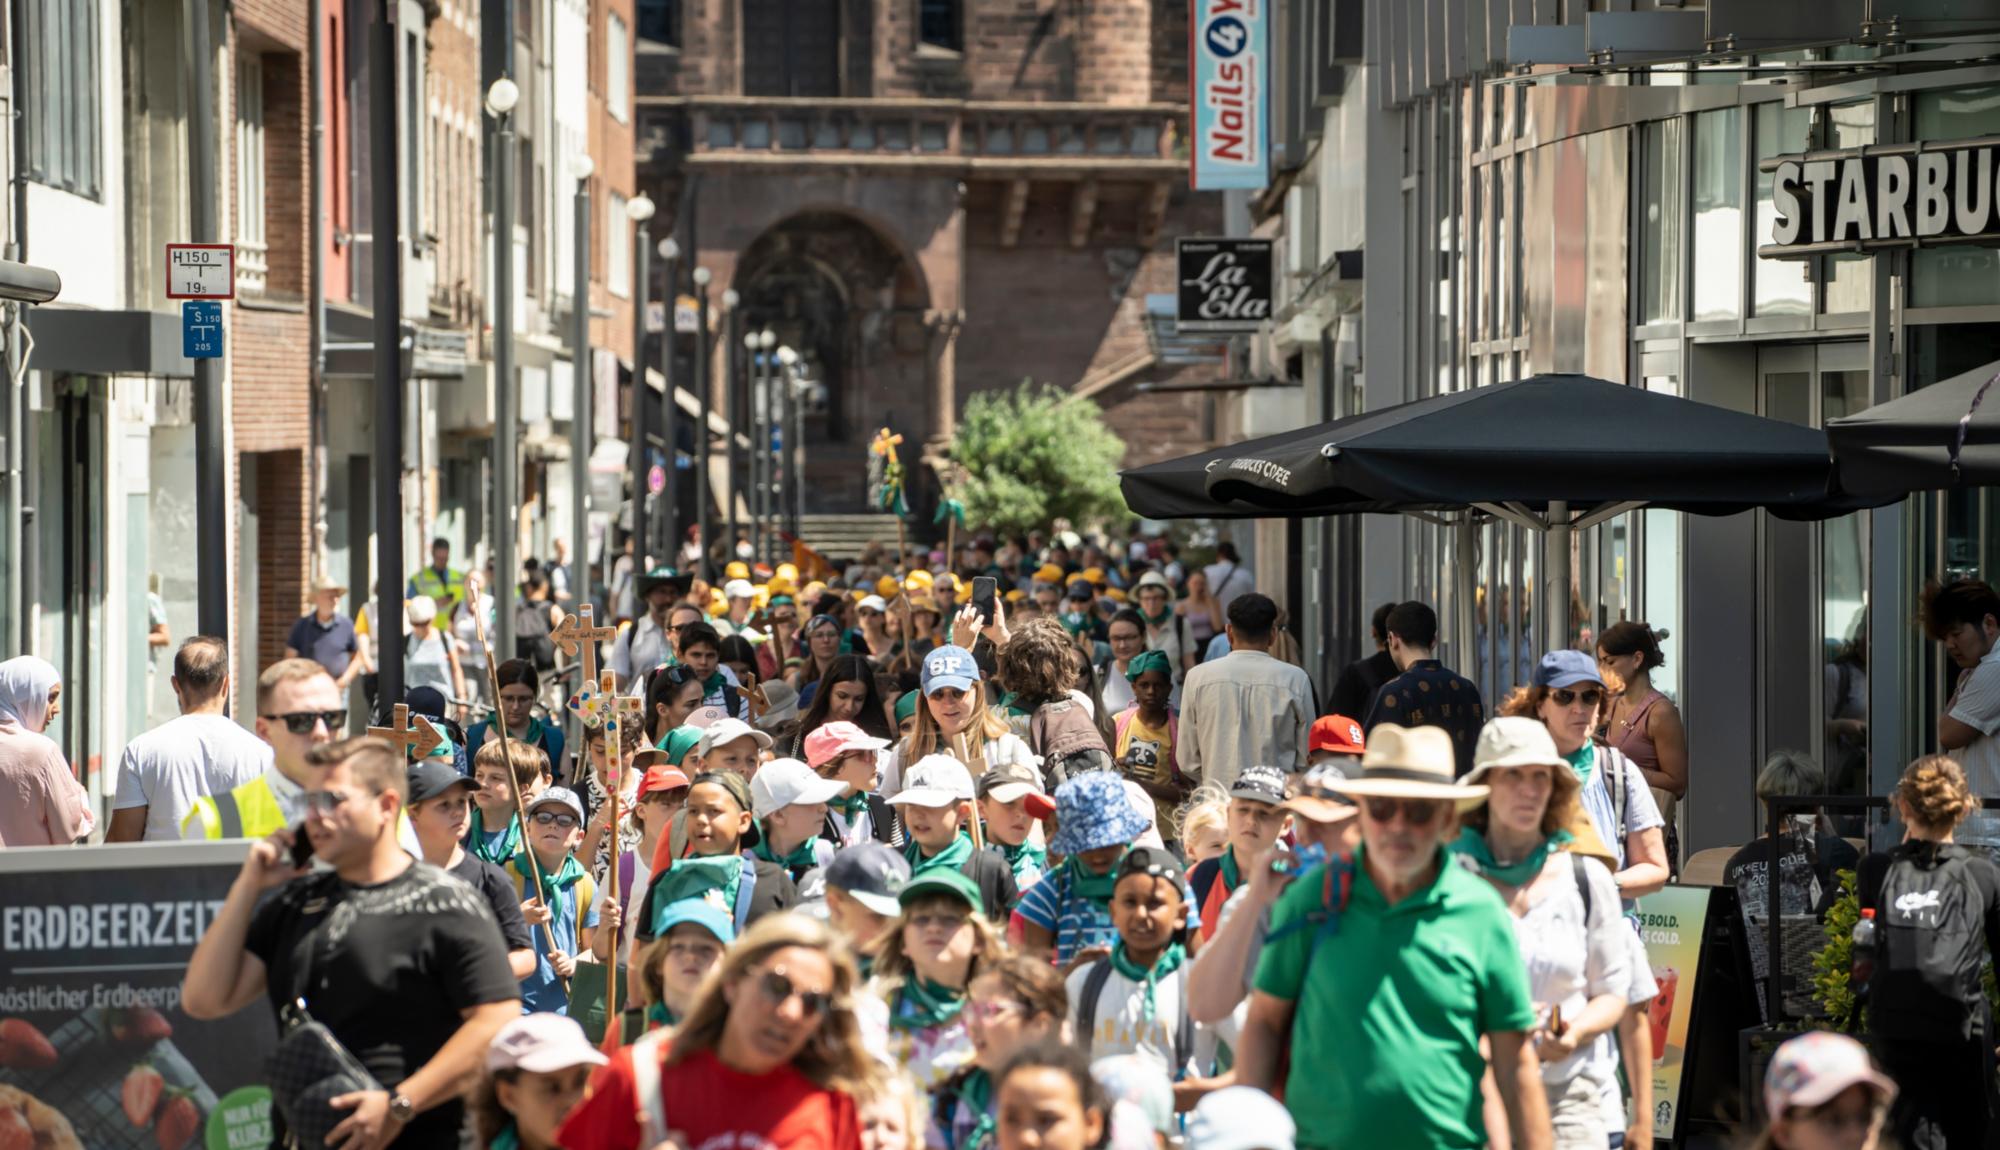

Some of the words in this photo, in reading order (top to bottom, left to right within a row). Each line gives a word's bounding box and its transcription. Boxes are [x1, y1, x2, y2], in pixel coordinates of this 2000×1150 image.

[1772, 148, 2000, 246] STARBU
[1648, 914, 1679, 928] BOLD.
[1651, 931, 1681, 945] COLD.
